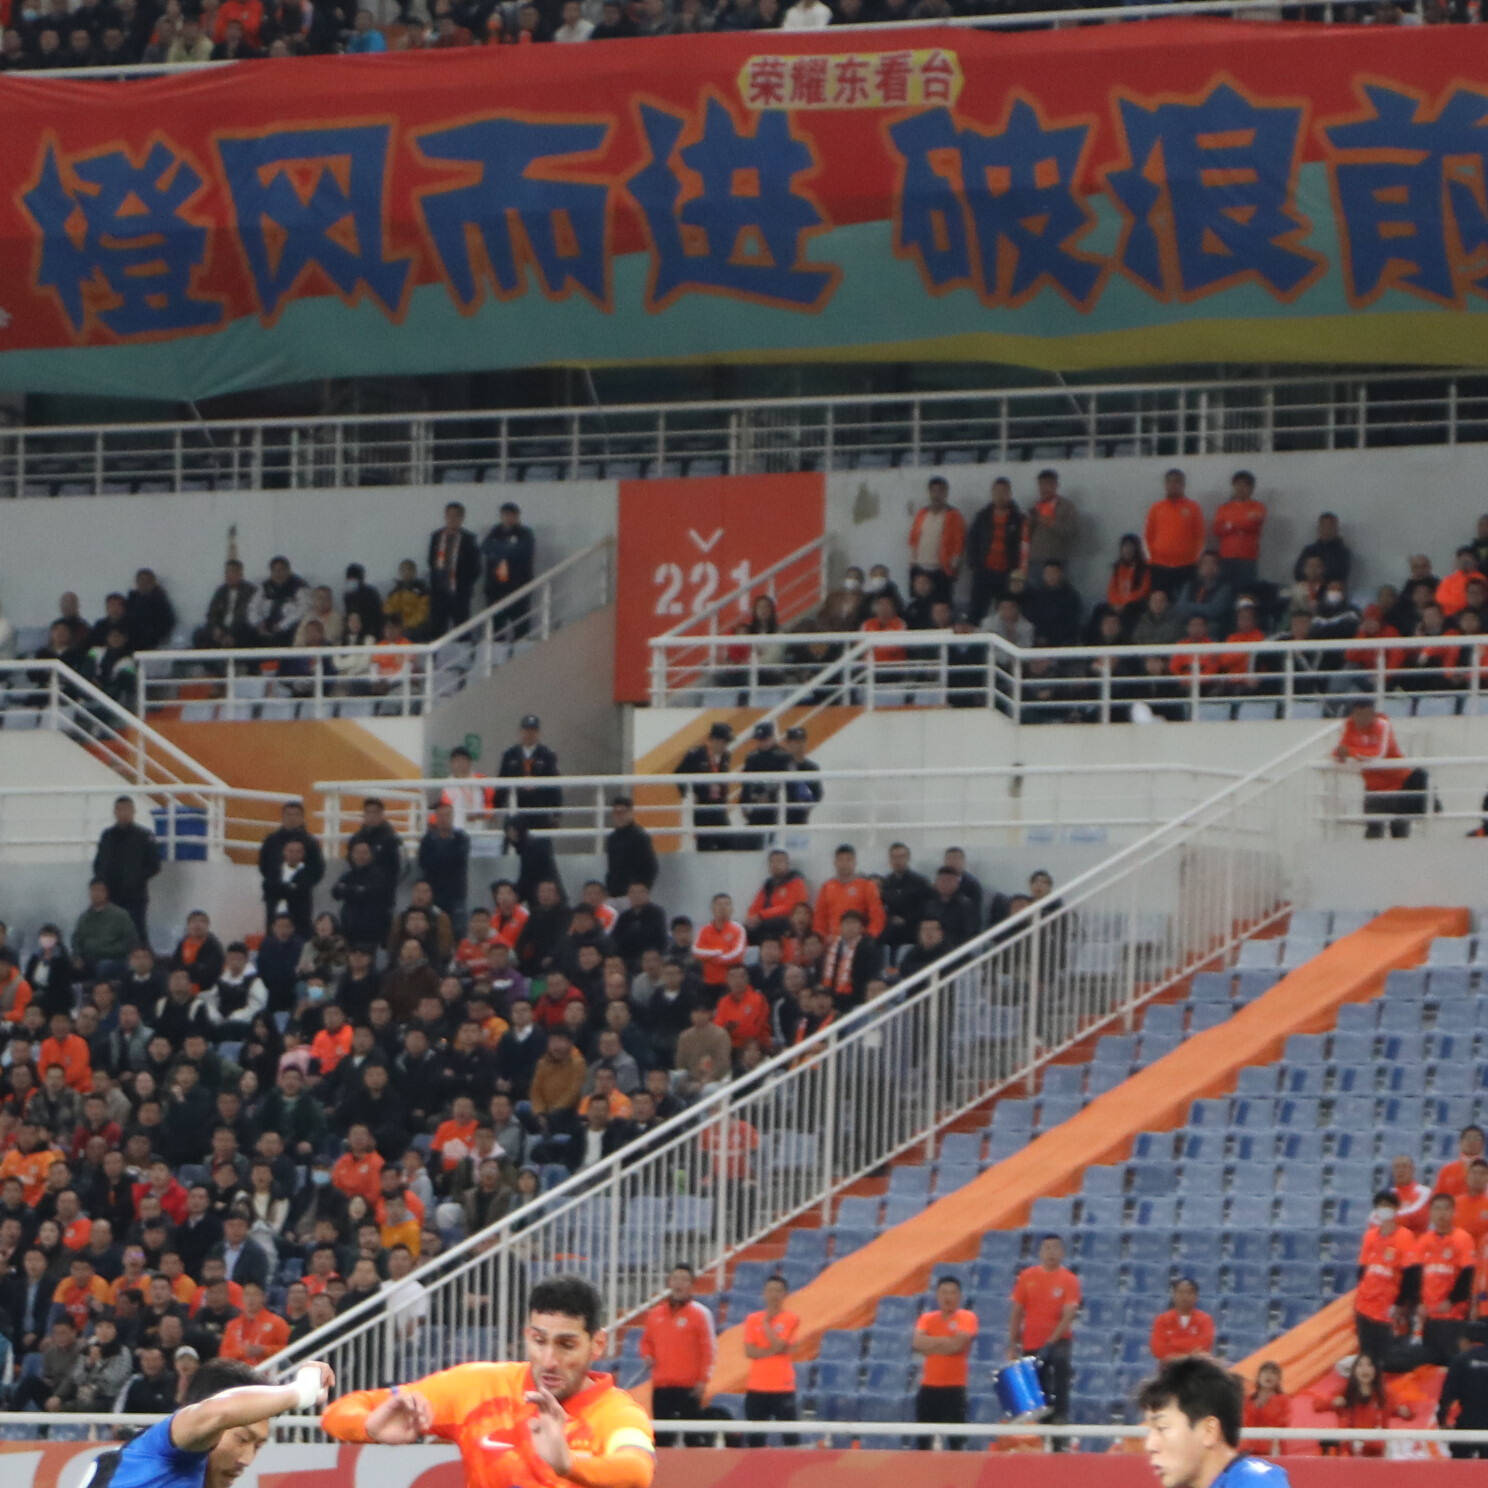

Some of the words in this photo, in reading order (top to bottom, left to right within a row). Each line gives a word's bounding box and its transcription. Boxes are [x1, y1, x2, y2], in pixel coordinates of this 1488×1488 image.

[747, 51, 958, 107] 荣耀东看台
[18, 92, 844, 344] 橙风而进
[653, 559, 752, 616] 221
